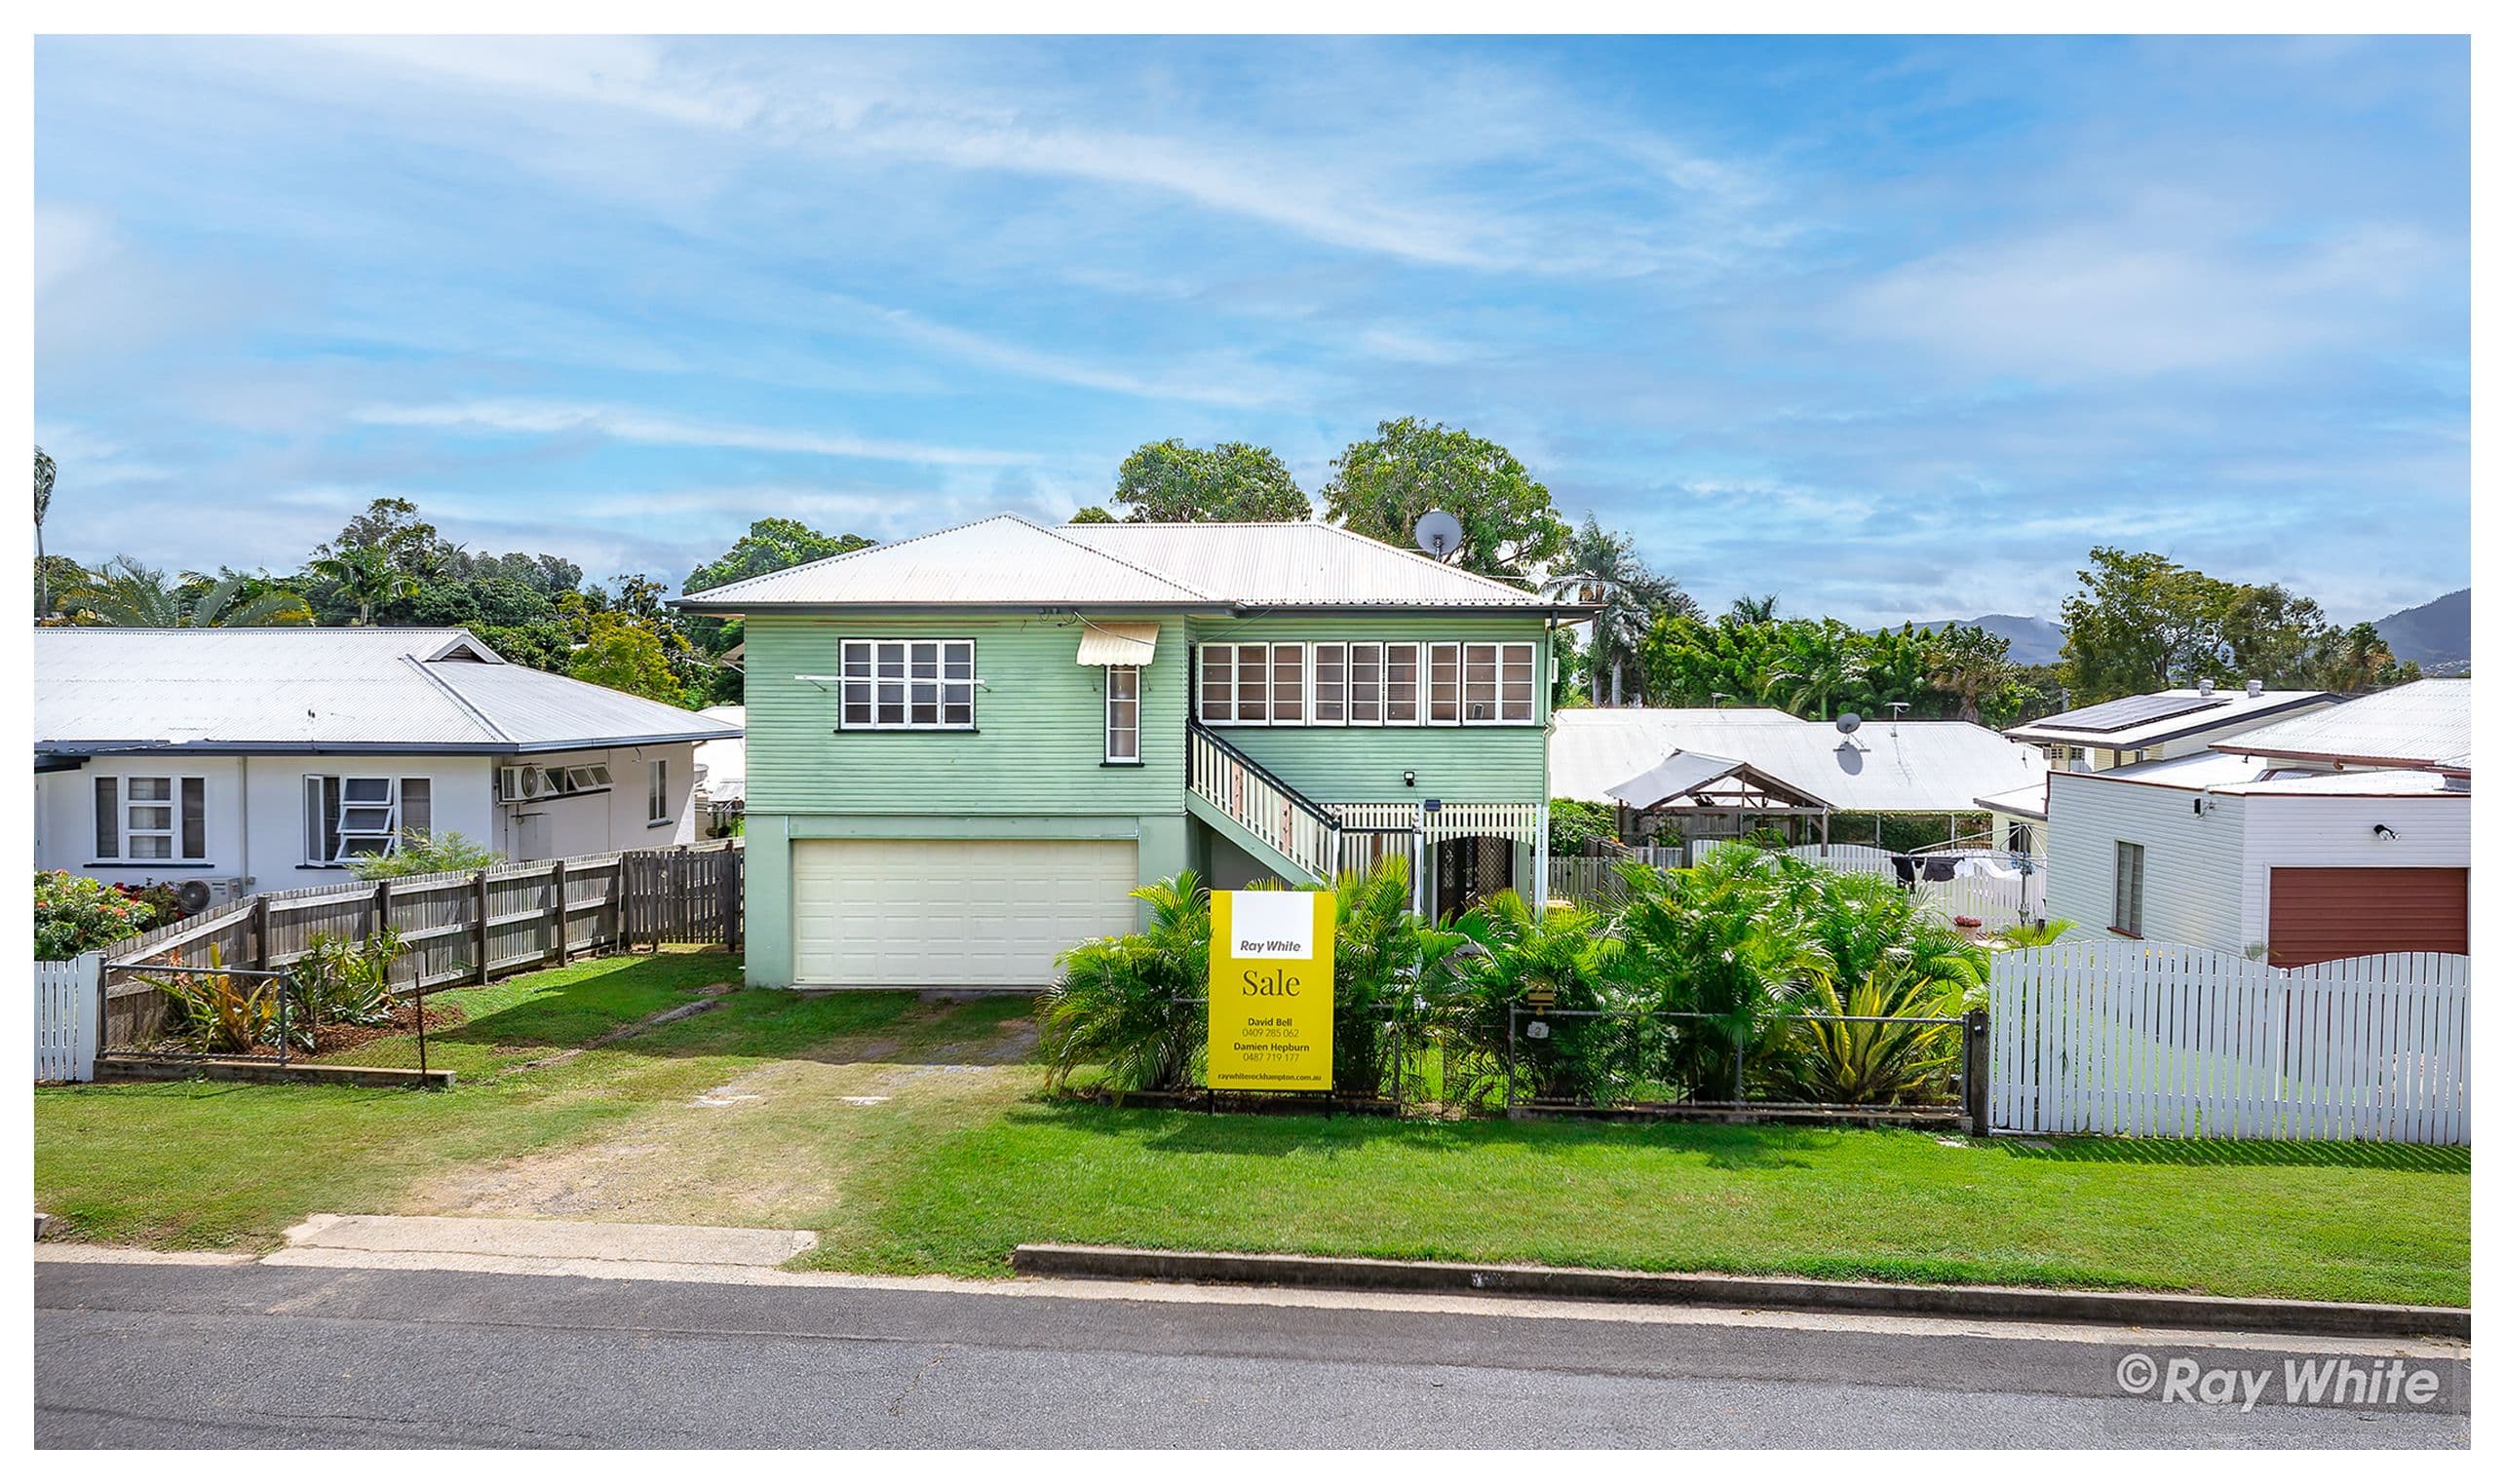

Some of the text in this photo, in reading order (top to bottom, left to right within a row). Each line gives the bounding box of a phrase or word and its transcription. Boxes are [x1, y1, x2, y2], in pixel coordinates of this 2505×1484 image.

[1241, 940, 1301, 953] Ray White
[1242, 969, 1301, 997] Sale
[1248, 1017, 1292, 1027] David Bell
[1242, 1028, 1300, 1038] 0409 285 062
[1233, 1042, 1310, 1053] Damien Hepburn
[1243, 1052, 1299, 1063] 0487 719 177
[1217, 1072, 1322, 1083] raywhiterockhampton.com.au
